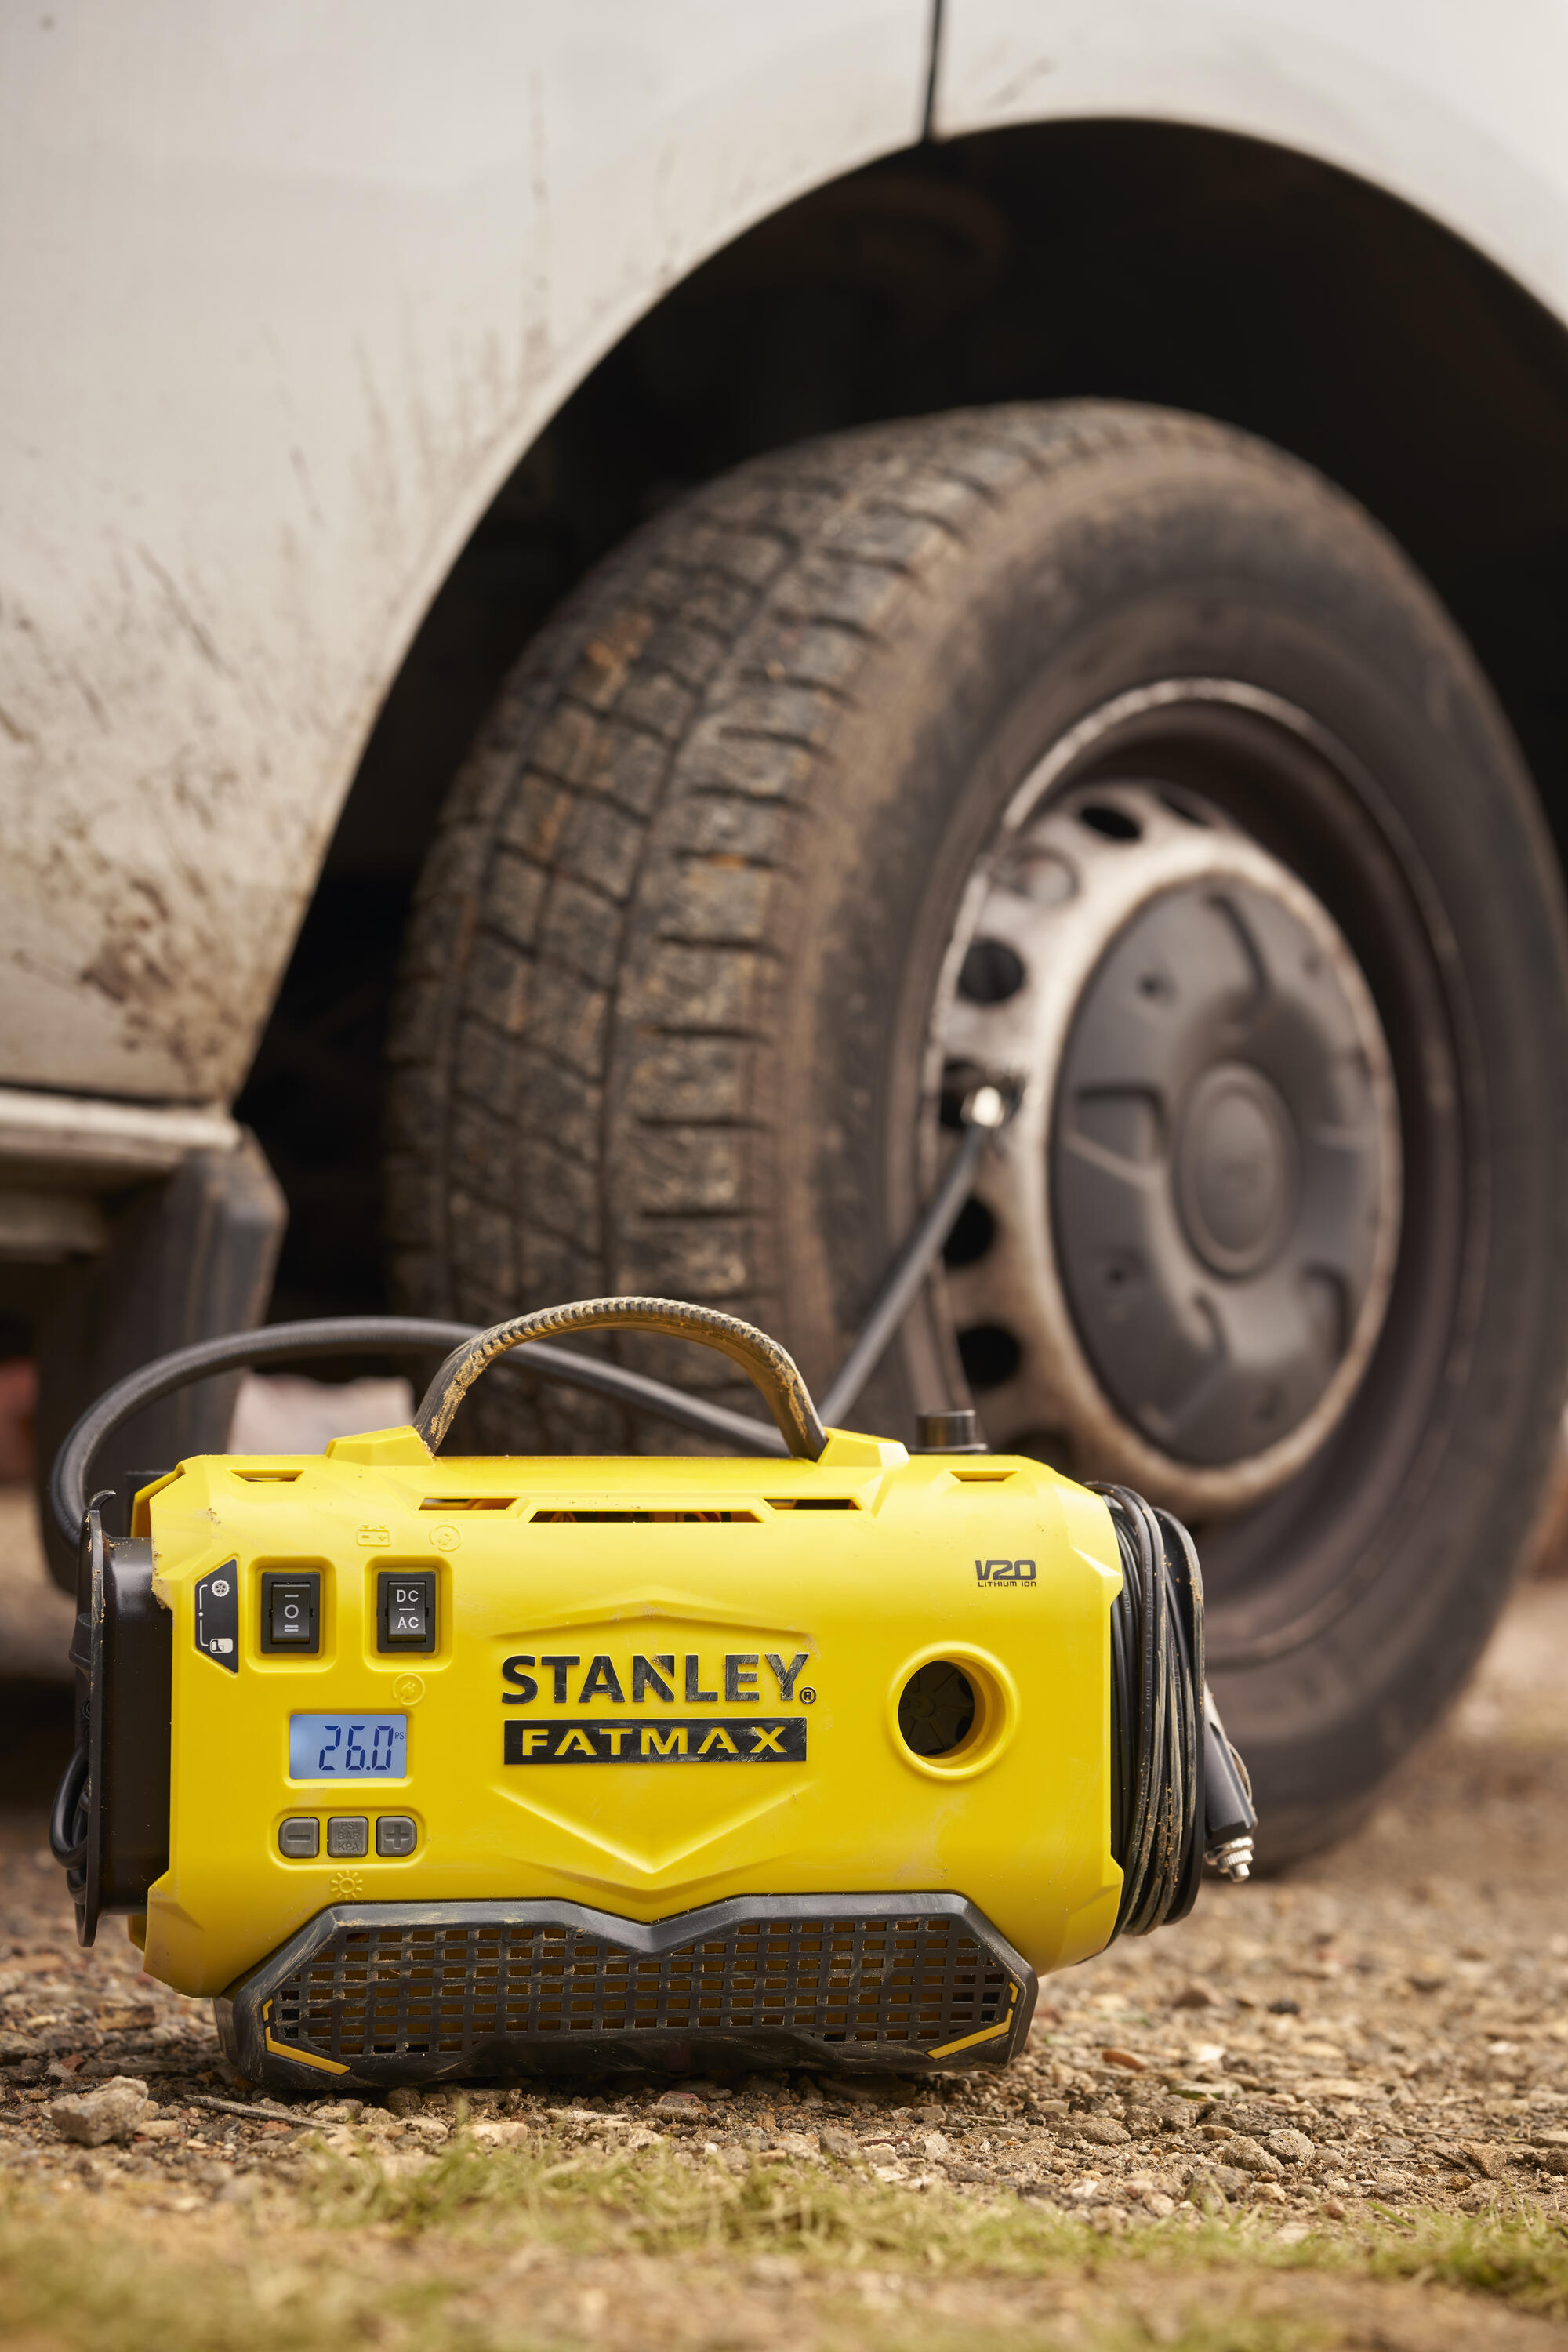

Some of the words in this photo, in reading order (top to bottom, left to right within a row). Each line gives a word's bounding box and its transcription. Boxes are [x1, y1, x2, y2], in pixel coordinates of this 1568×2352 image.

[975, 1559, 1036, 1581] V20
[396, 1589, 419, 1602] DC
[397, 1617, 419, 1629] AC
[521, 1726, 788, 1757] FATMAX
[318, 1725, 394, 1771] 26.0
[394, 1731, 407, 1740] PSI
[340, 1821, 358, 1830] PSI
[337, 1831, 360, 1840] BAR
[338, 1842, 360, 1851] KPA
